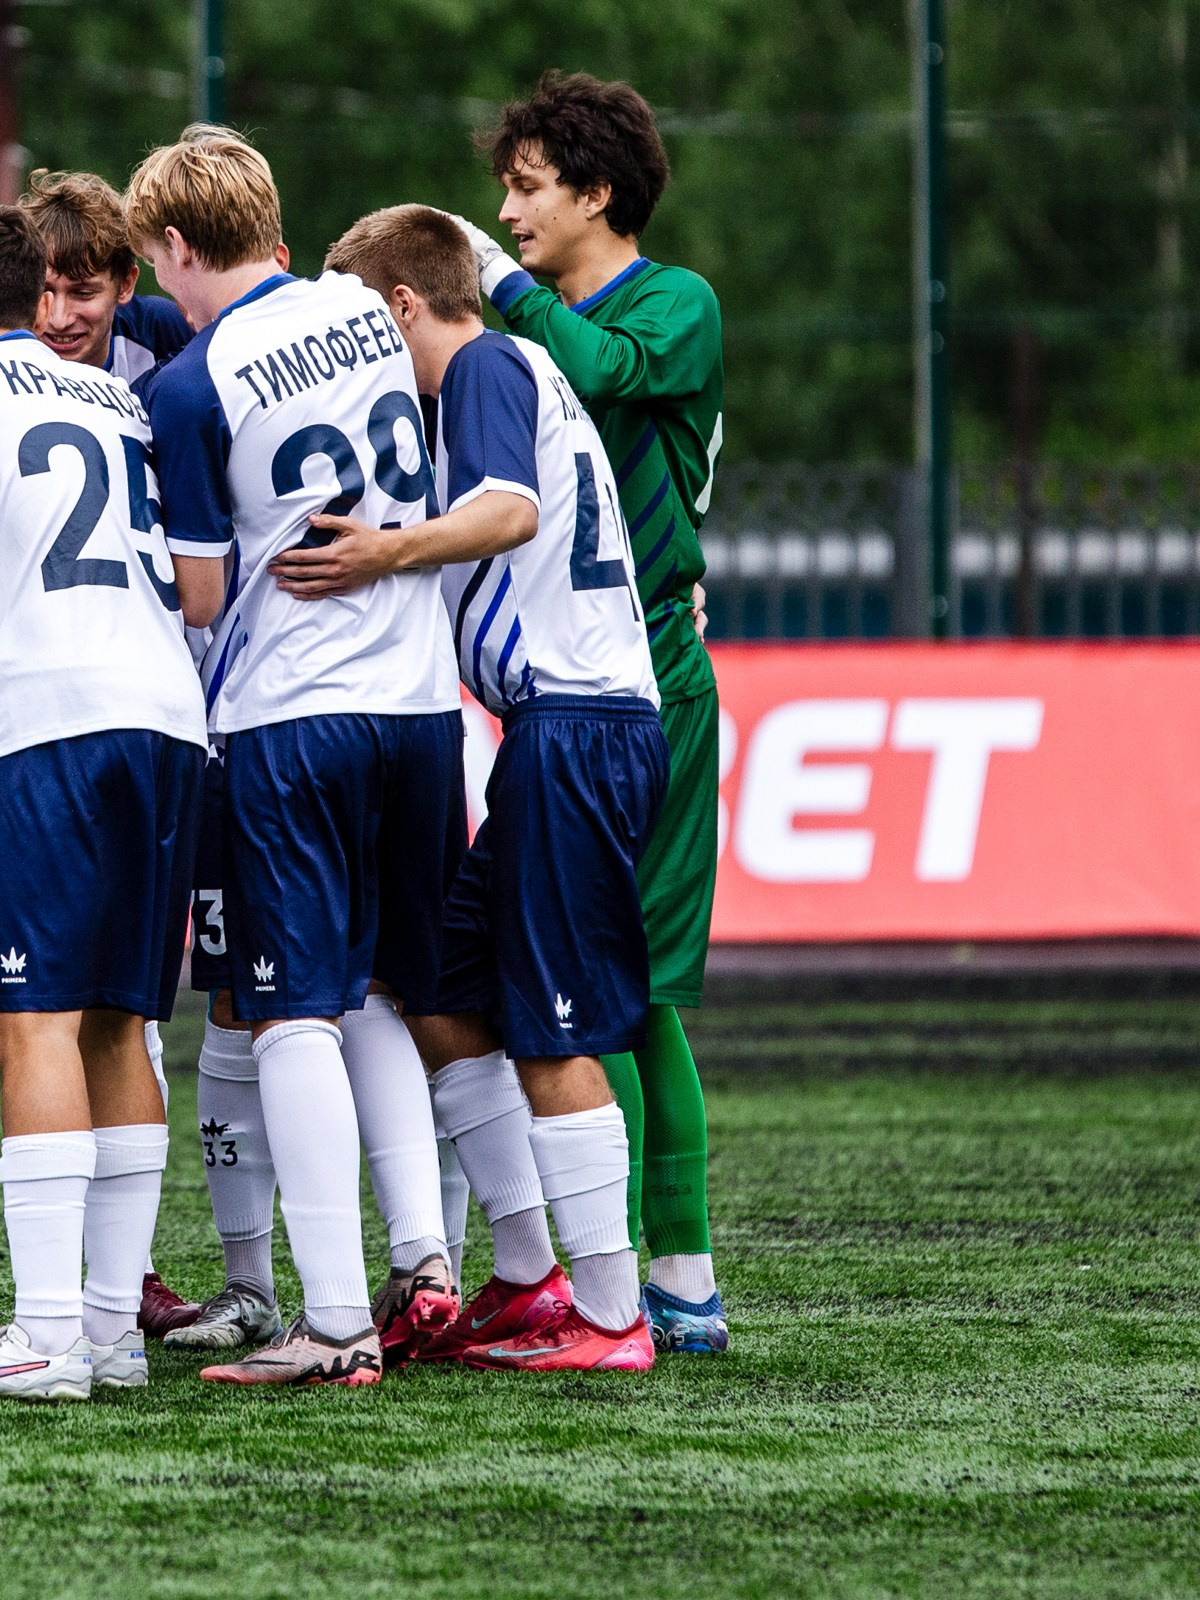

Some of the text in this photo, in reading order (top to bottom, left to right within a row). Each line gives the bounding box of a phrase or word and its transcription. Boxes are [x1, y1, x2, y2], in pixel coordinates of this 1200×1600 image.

[234, 308, 403, 409] ТИМОФЕЕВ
[18, 421, 182, 612] 25
[271, 390, 442, 565] 29
[717, 697, 1045, 883] ET
[191, 889, 227, 955] 3
[203, 1140, 238, 1167] 33
